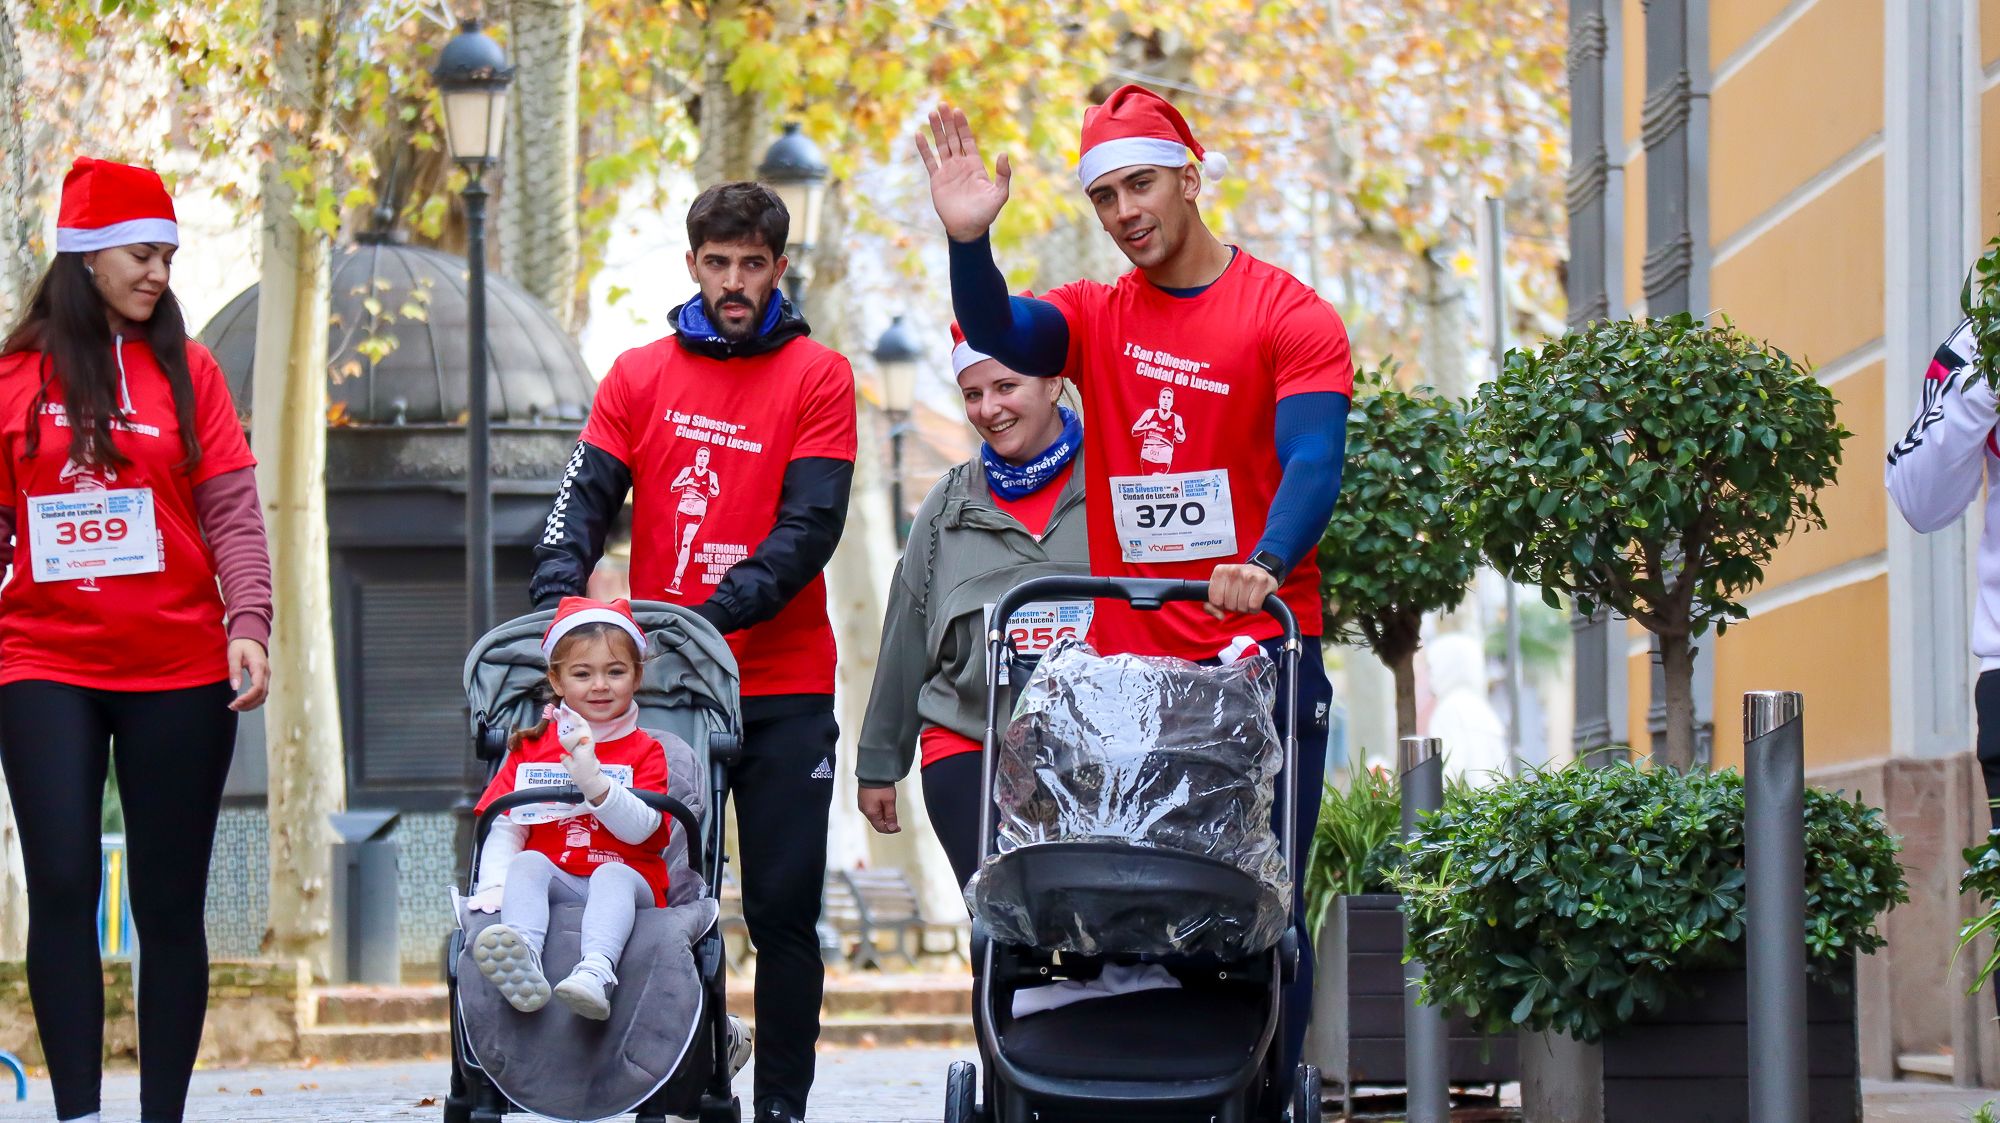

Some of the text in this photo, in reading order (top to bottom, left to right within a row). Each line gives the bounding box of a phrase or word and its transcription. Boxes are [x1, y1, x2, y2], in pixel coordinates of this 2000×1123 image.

[1124, 342, 1200, 374] I San Silvestre
[1136, 362, 1230, 396] Ciudad de Lucena
[47, 402, 67, 415] Sa
[664, 409, 672, 422] I
[672, 411, 690, 425] San
[692, 414, 738, 435] Silvestre
[675, 424, 762, 454] Ciudad de Lucena
[1026, 442, 1070, 475] enerplus
[1122, 486, 1134, 494] San
[1154, 492, 1178, 500] Lucena
[56, 503, 86, 511] Silvestre
[41, 511, 66, 520] Ciudad
[77, 508, 102, 517] Lucena
[1135, 501, 1206, 528] 370
[56, 518, 128, 546] 369
[703, 542, 748, 555] MEMORIAL
[1190, 539, 1223, 547] enerplus
[694, 552, 714, 564] JOSE
[810, 771, 833, 779] adida
